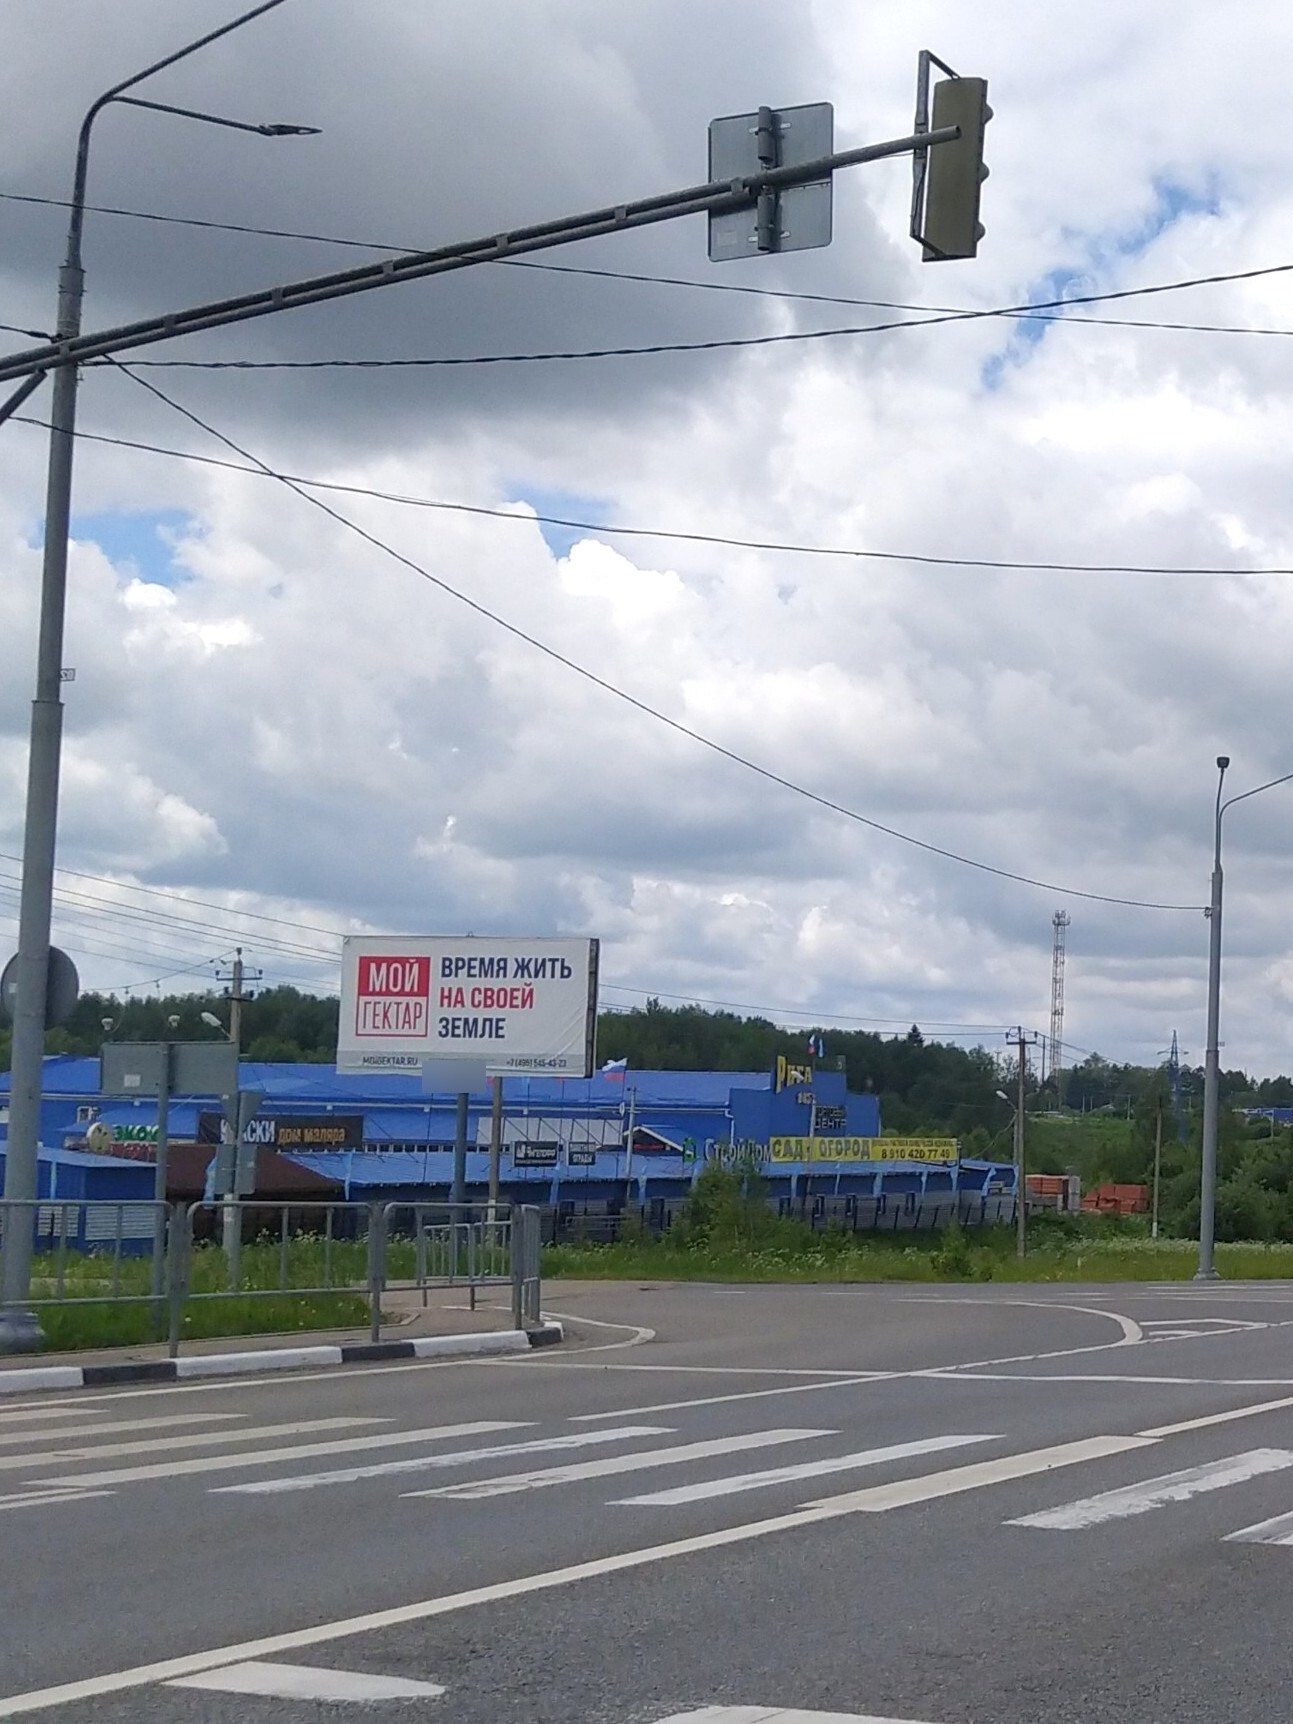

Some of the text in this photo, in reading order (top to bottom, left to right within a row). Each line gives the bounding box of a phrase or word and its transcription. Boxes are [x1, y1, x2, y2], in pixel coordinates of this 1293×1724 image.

[369, 959, 419, 993] МОЙ
[441, 957, 573, 980] ВРЕМЯ ЖИТЬ
[439, 982, 534, 1009] НА СВОЕЙ
[363, 1001, 423, 1031] ГЕКТАР
[438, 1017, 506, 1040] ЗЕМЛЕ
[772, 1138, 870, 1160] САД ОГОРОД
[881, 1149, 887, 1159] 8
[890, 1149, 906, 1159] 910
[908, 1149, 926, 1159] 420
[928, 1149, 939, 1159] 77
